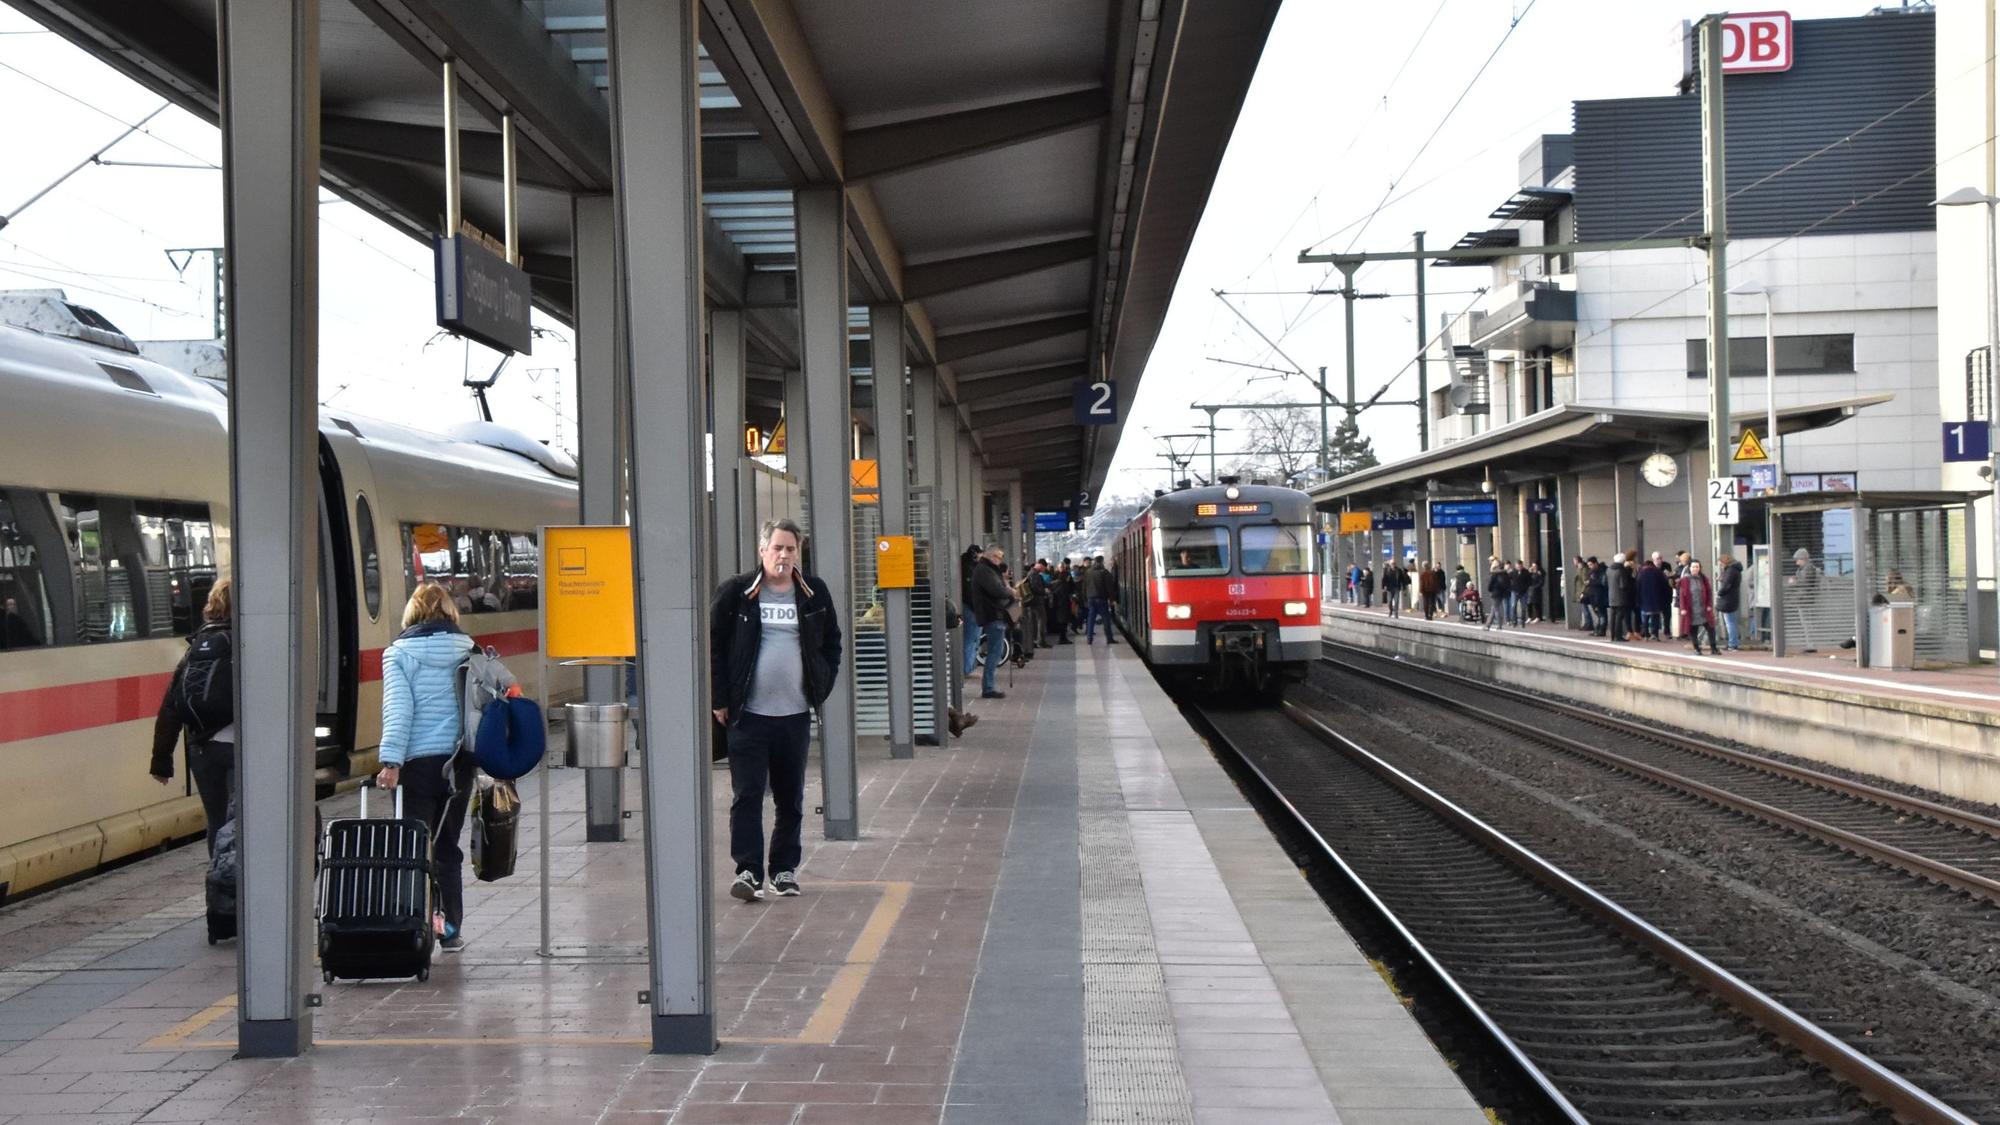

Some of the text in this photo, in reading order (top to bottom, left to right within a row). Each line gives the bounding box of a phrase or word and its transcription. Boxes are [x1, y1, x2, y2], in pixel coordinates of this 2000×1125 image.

[1721, 22, 1780, 63] DB
[1090, 382, 1111, 414] 2
[1950, 425, 1964, 454] 1
[1080, 491, 1089, 506] 2
[1710, 481, 1736, 499] 24
[1718, 501, 1730, 519] 4
